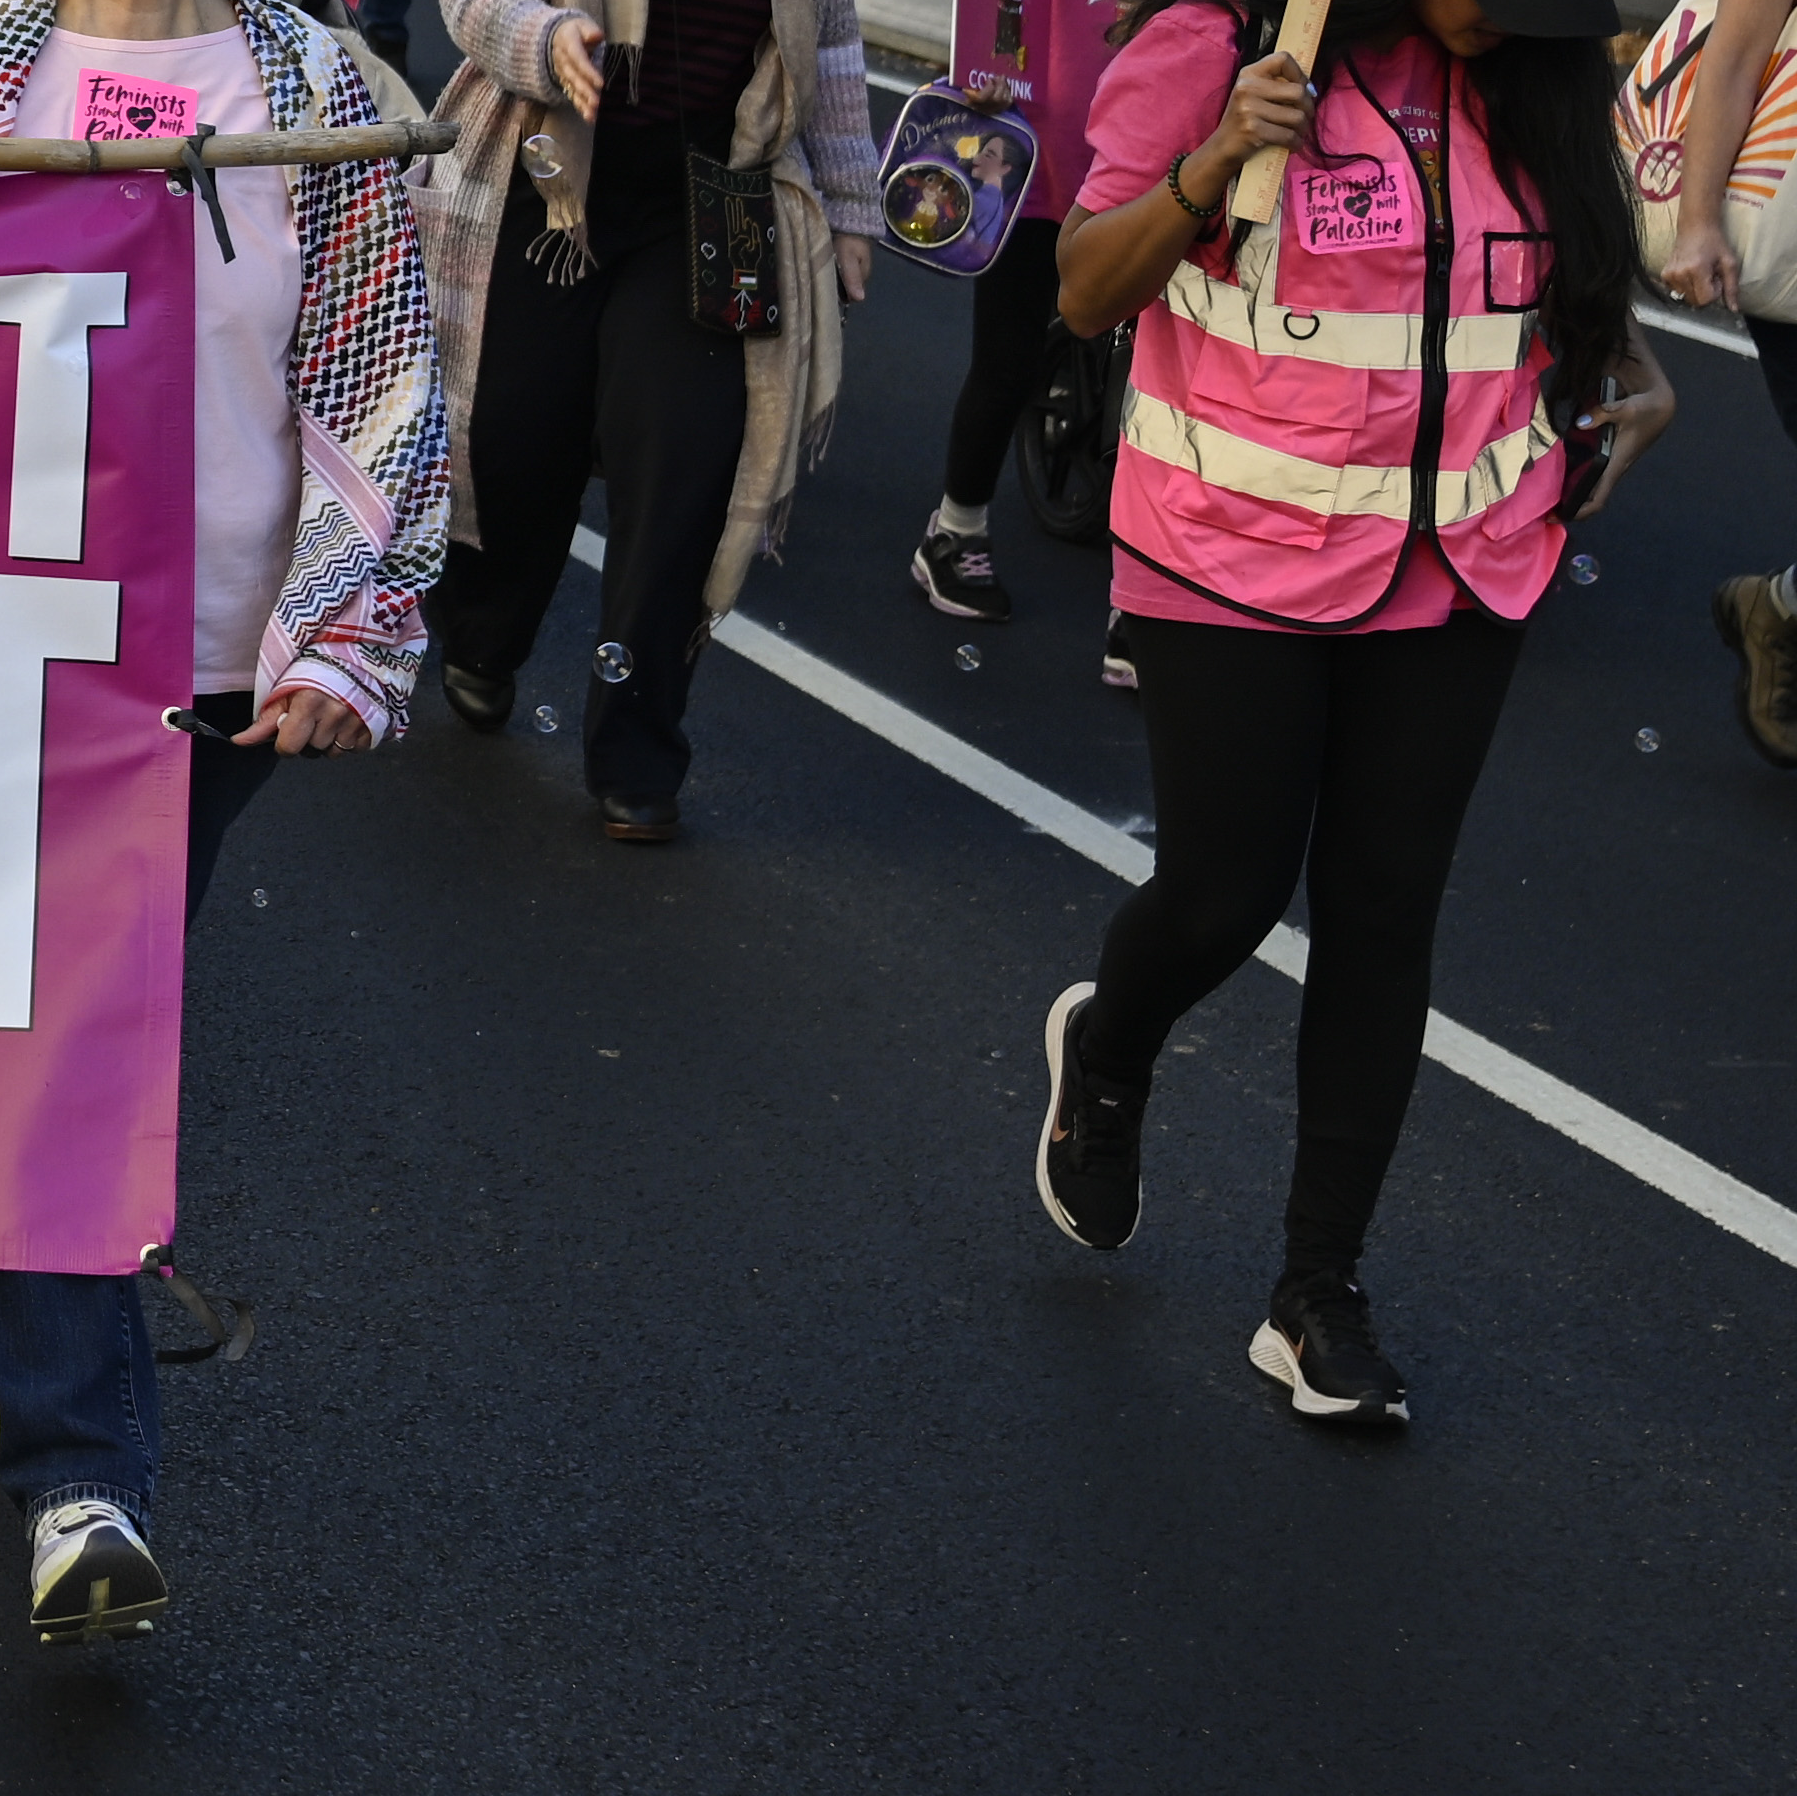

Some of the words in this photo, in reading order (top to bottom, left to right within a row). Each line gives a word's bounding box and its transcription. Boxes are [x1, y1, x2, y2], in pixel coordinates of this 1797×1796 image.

[88, 75, 186, 118] Feminists
[85, 103, 123, 121] stand
[159, 118, 185, 136] with
[1300, 173, 1397, 203] Feminists
[1304, 196, 1341, 218] stand
[1375, 194, 1402, 210] with
[1309, 216, 1404, 247] Palestine
